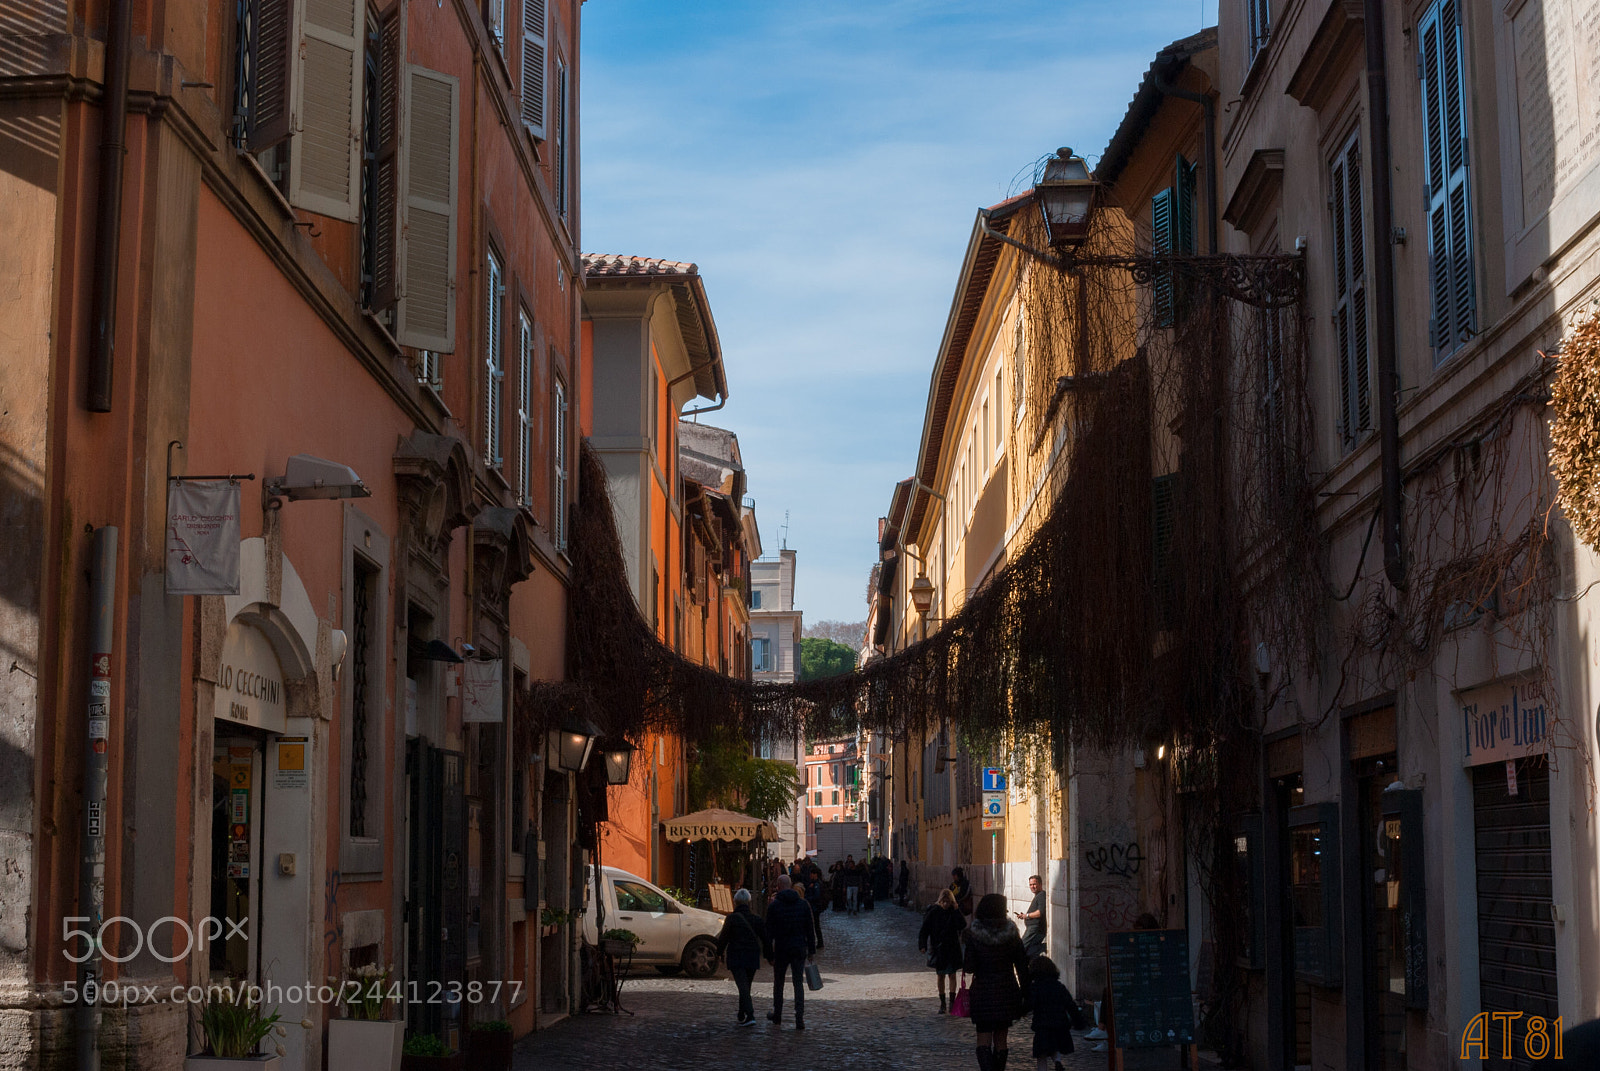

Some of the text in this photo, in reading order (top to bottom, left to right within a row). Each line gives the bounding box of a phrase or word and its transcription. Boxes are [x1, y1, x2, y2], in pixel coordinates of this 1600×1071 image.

[216, 663, 281, 706] LO CECCHINI
[230, 701, 249, 721] ROMA
[1462, 702, 1498, 757] Fior
[1500, 704, 1511, 741] di
[670, 824, 755, 837] RISTORANTE
